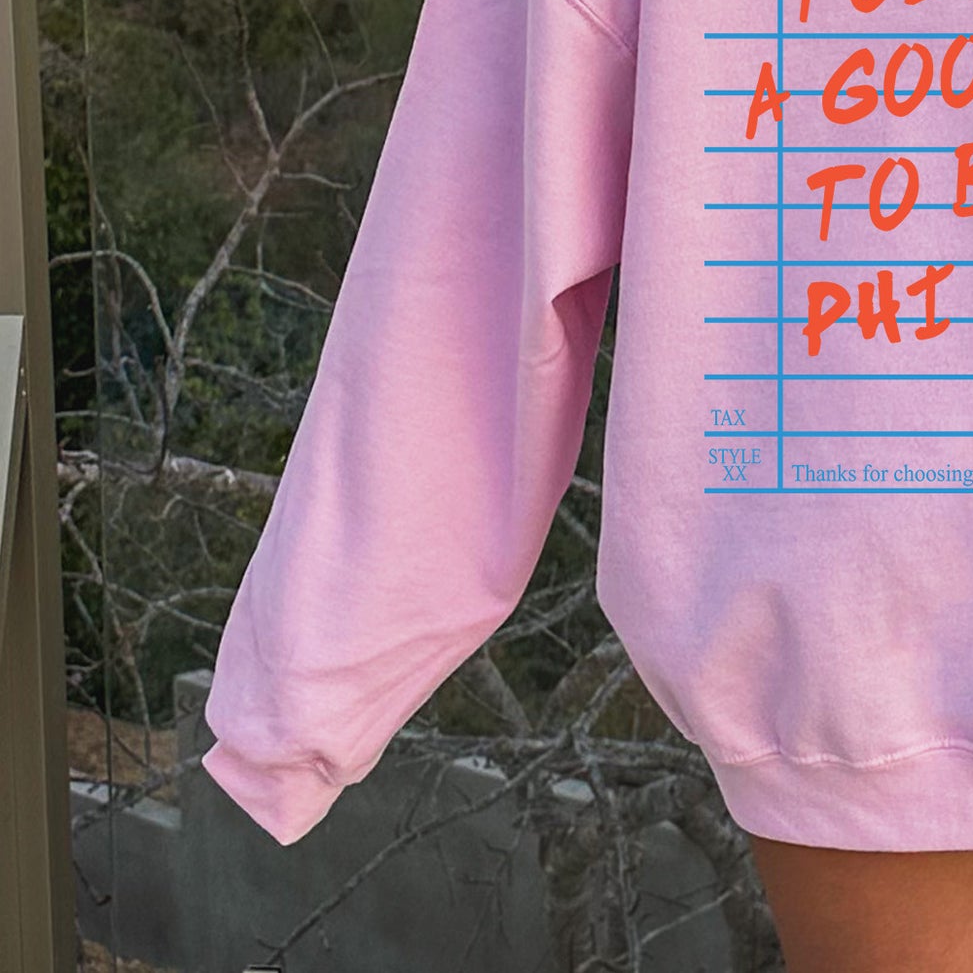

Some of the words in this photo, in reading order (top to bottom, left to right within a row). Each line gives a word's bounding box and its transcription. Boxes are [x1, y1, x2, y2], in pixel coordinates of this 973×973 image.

[745, 61, 791, 141] A
[806, 157, 920, 242] TO
[802, 264, 955, 357] PHI
[711, 409, 746, 426] TAX
[708, 448, 762, 465] STYLE
[723, 465, 747, 482] XX
[791, 464, 857, 482] Thanks
[862, 464, 889, 482] for
[893, 464, 973, 487] choosing
